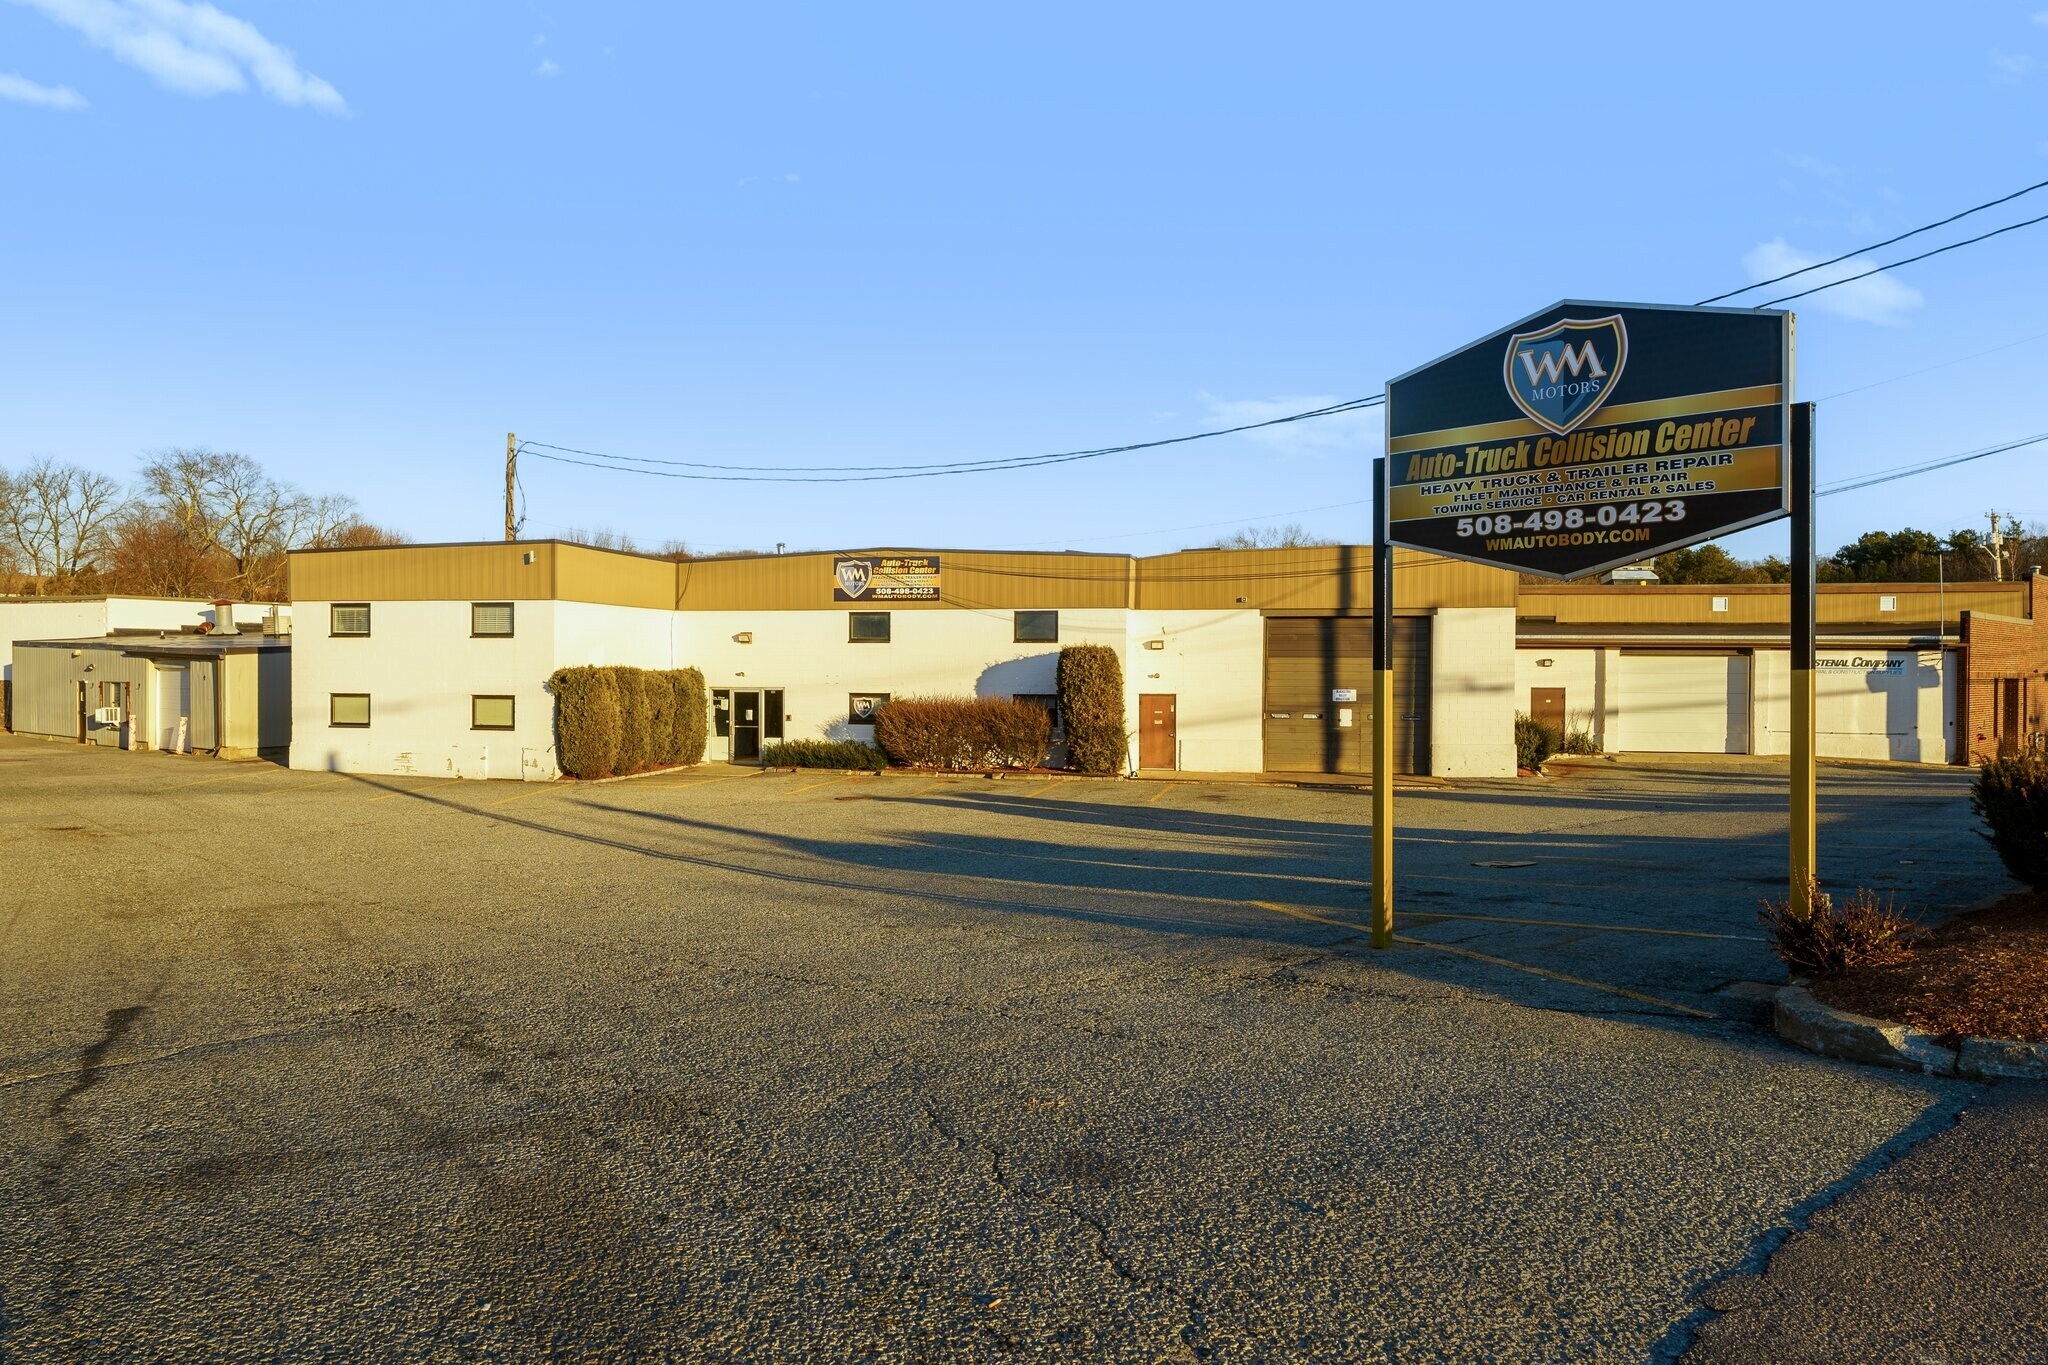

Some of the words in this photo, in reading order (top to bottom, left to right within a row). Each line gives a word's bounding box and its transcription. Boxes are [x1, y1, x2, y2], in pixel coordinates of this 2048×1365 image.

[1518, 340, 1607, 387] WM
[1532, 380, 1600, 401] MOTORS
[1406, 440, 1531, 481] Auto-Truck
[1534, 428, 1650, 467] Collision
[1655, 416, 1756, 454] Center
[1420, 480, 1475, 496] HEAVY
[1480, 473, 1541, 490] TRUCK
[1547, 471, 1560, 483] &
[1566, 462, 1648, 481] TRAILER
[1655, 453, 1733, 471] REPAIR
[1454, 491, 1495, 502] FLEET
[1498, 475, 1606, 498] MAINTENANCE
[1611, 476, 1623, 487] &
[1628, 472, 1688, 486] REPAIR
[1433, 502, 1482, 514] TOWING
[1486, 497, 1542, 510] SERVICE
[1557, 492, 1586, 504] CAR
[1589, 488, 1645, 501] RENTAL
[1650, 485, 1661, 495] &
[1665, 480, 1716, 493] SALES
[1456, 500, 1686, 537] 508-498-0423
[1485, 527, 1650, 551] WMAUTOBODY.COM
[841, 567, 866, 580] WM
[880, 559, 929, 567] Auto-Truck
[909, 566, 936, 574] Center
